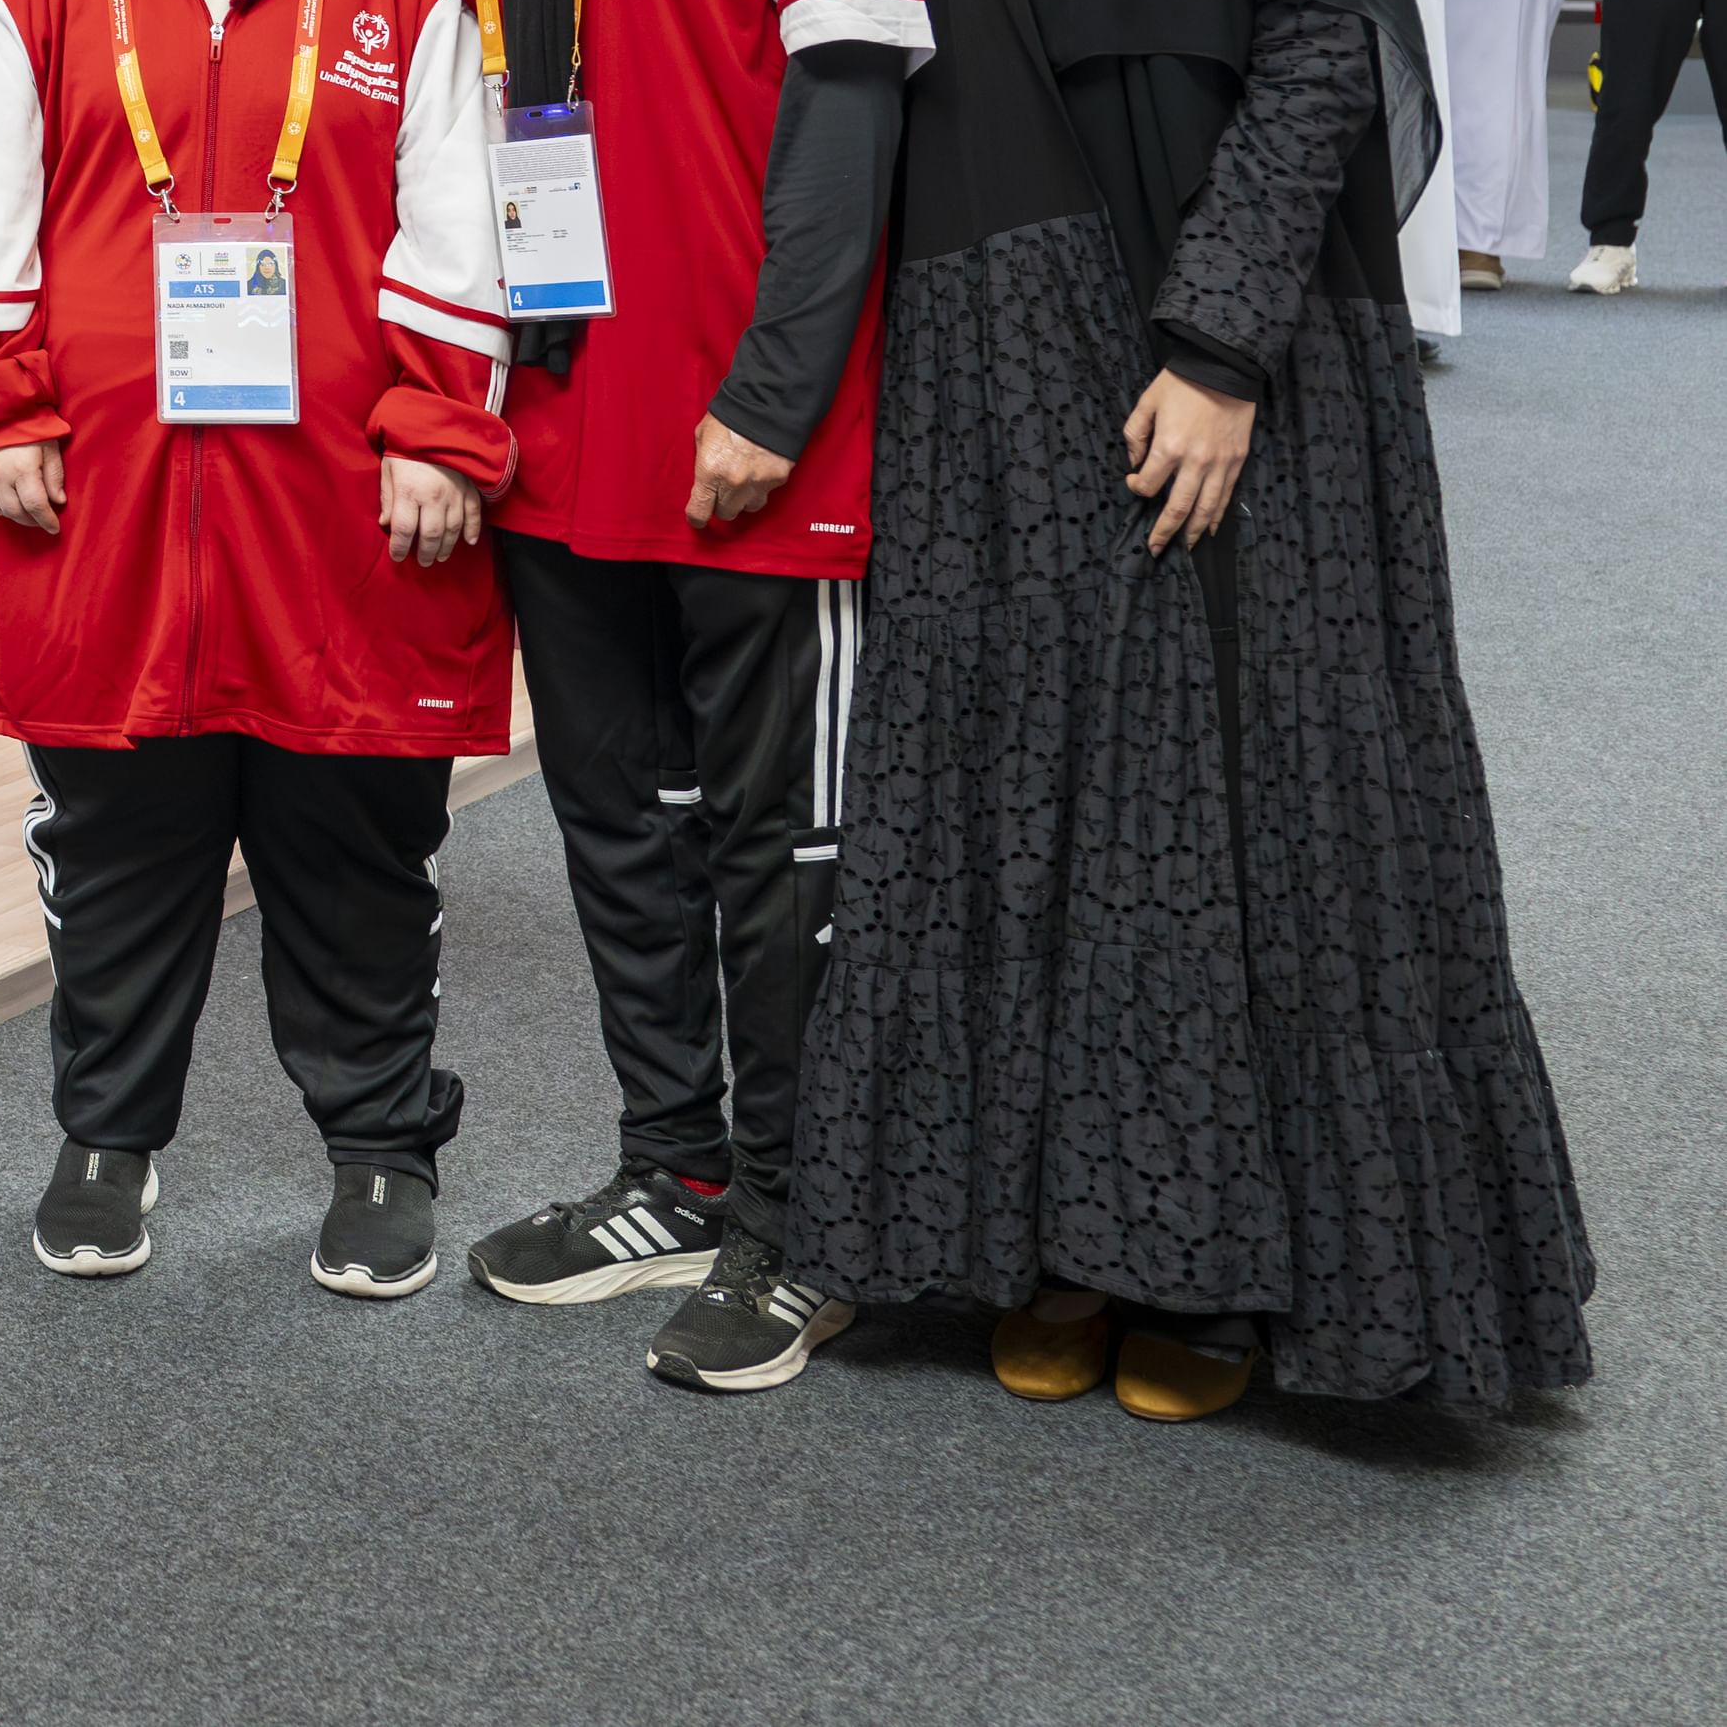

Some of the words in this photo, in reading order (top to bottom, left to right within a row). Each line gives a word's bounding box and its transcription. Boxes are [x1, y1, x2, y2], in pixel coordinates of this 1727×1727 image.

[194, 284, 215, 294] ATS
[514, 292, 523, 307] 4
[174, 391, 185, 406] 4
[810, 521, 855, 535] AEROREADY
[417, 698, 454, 709] AEROREADY
[674, 1206, 705, 1225] adidas
